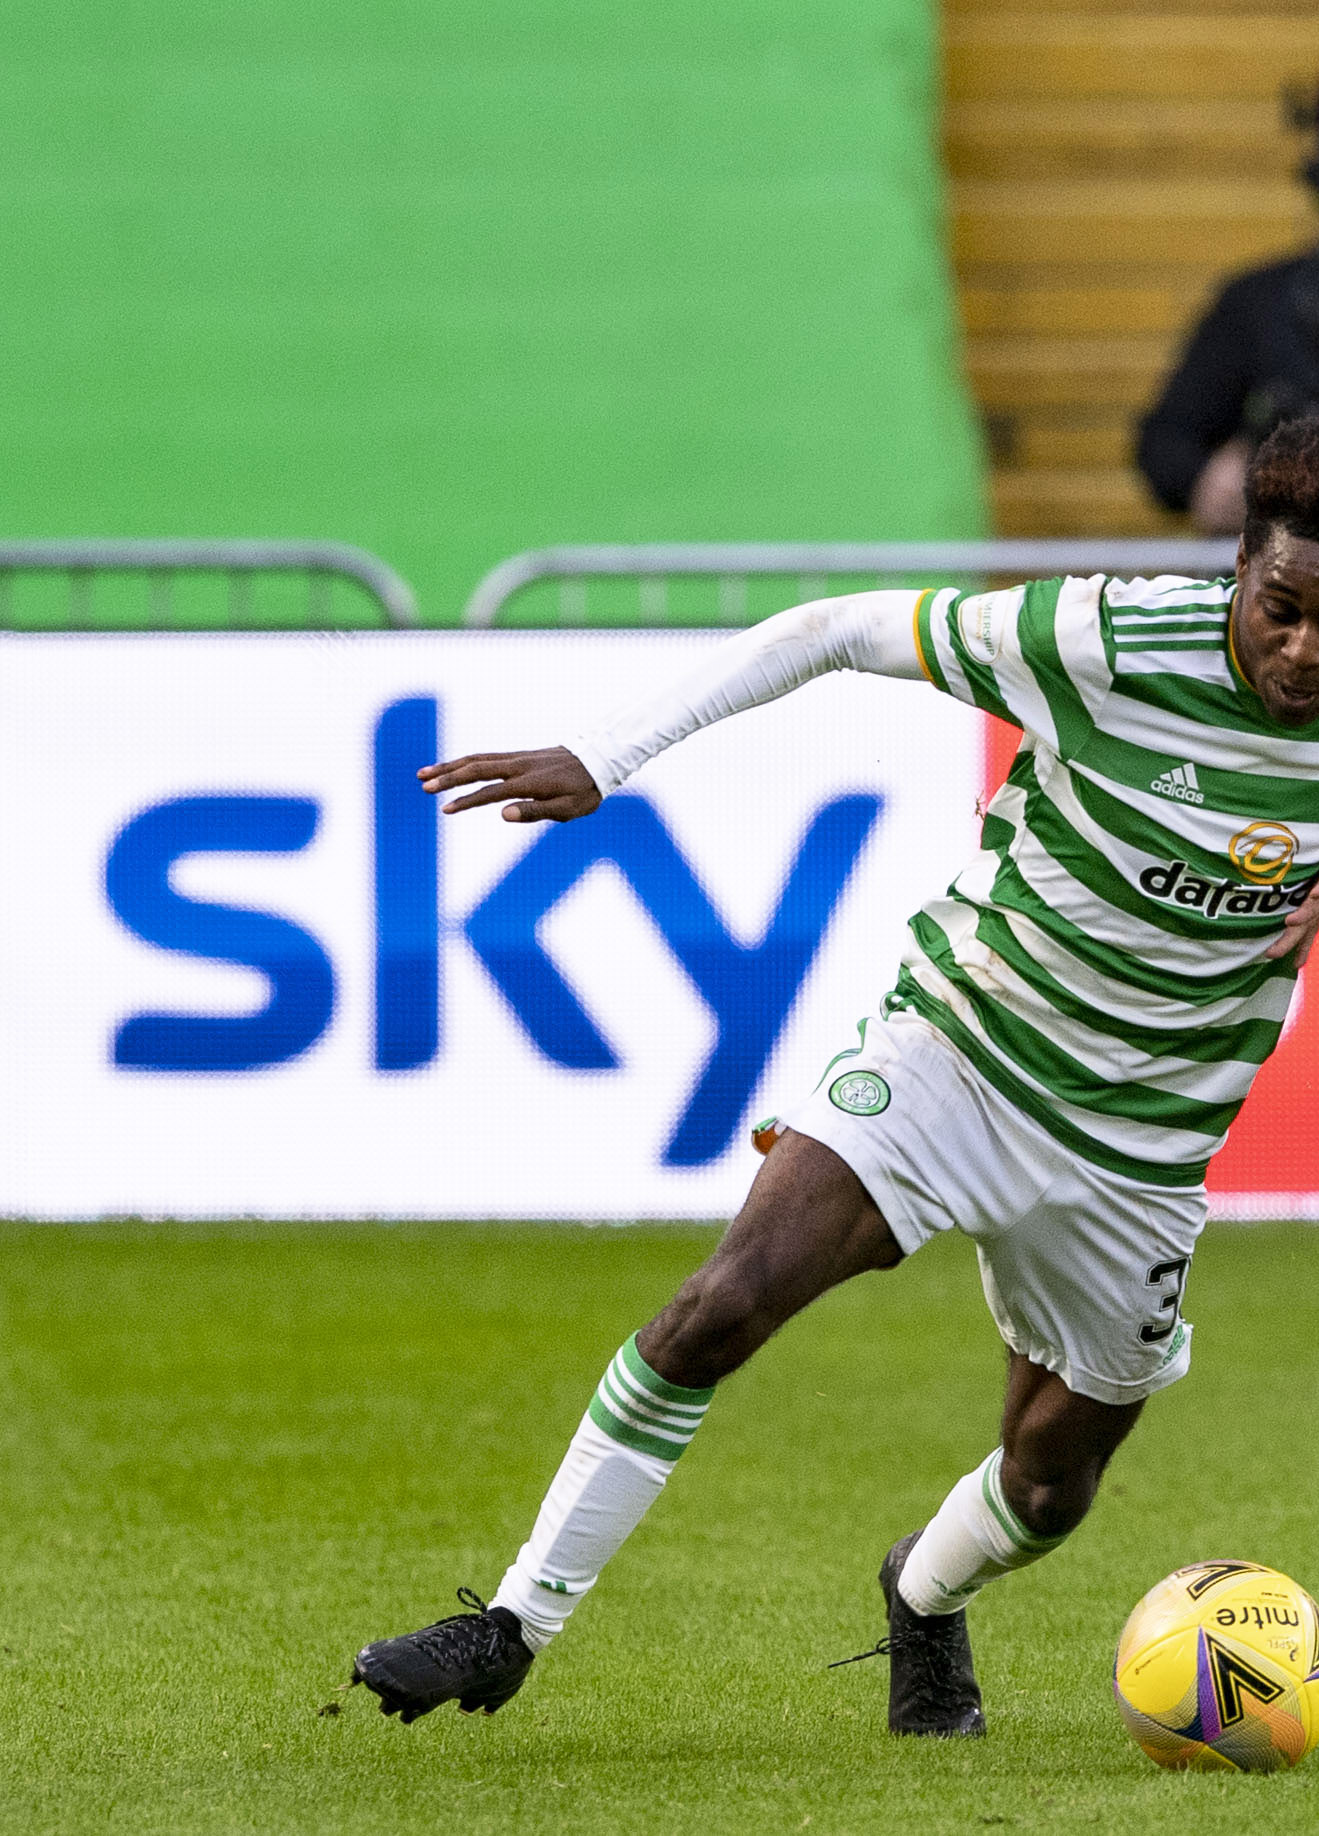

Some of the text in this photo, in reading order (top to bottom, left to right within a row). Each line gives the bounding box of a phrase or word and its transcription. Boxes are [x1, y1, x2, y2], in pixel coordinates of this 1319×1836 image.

[1150, 779, 1205, 804] adidas
[104, 692, 887, 1170] sky
[1137, 1255, 1191, 1346] 3
[1216, 1606, 1299, 1630] mitre
